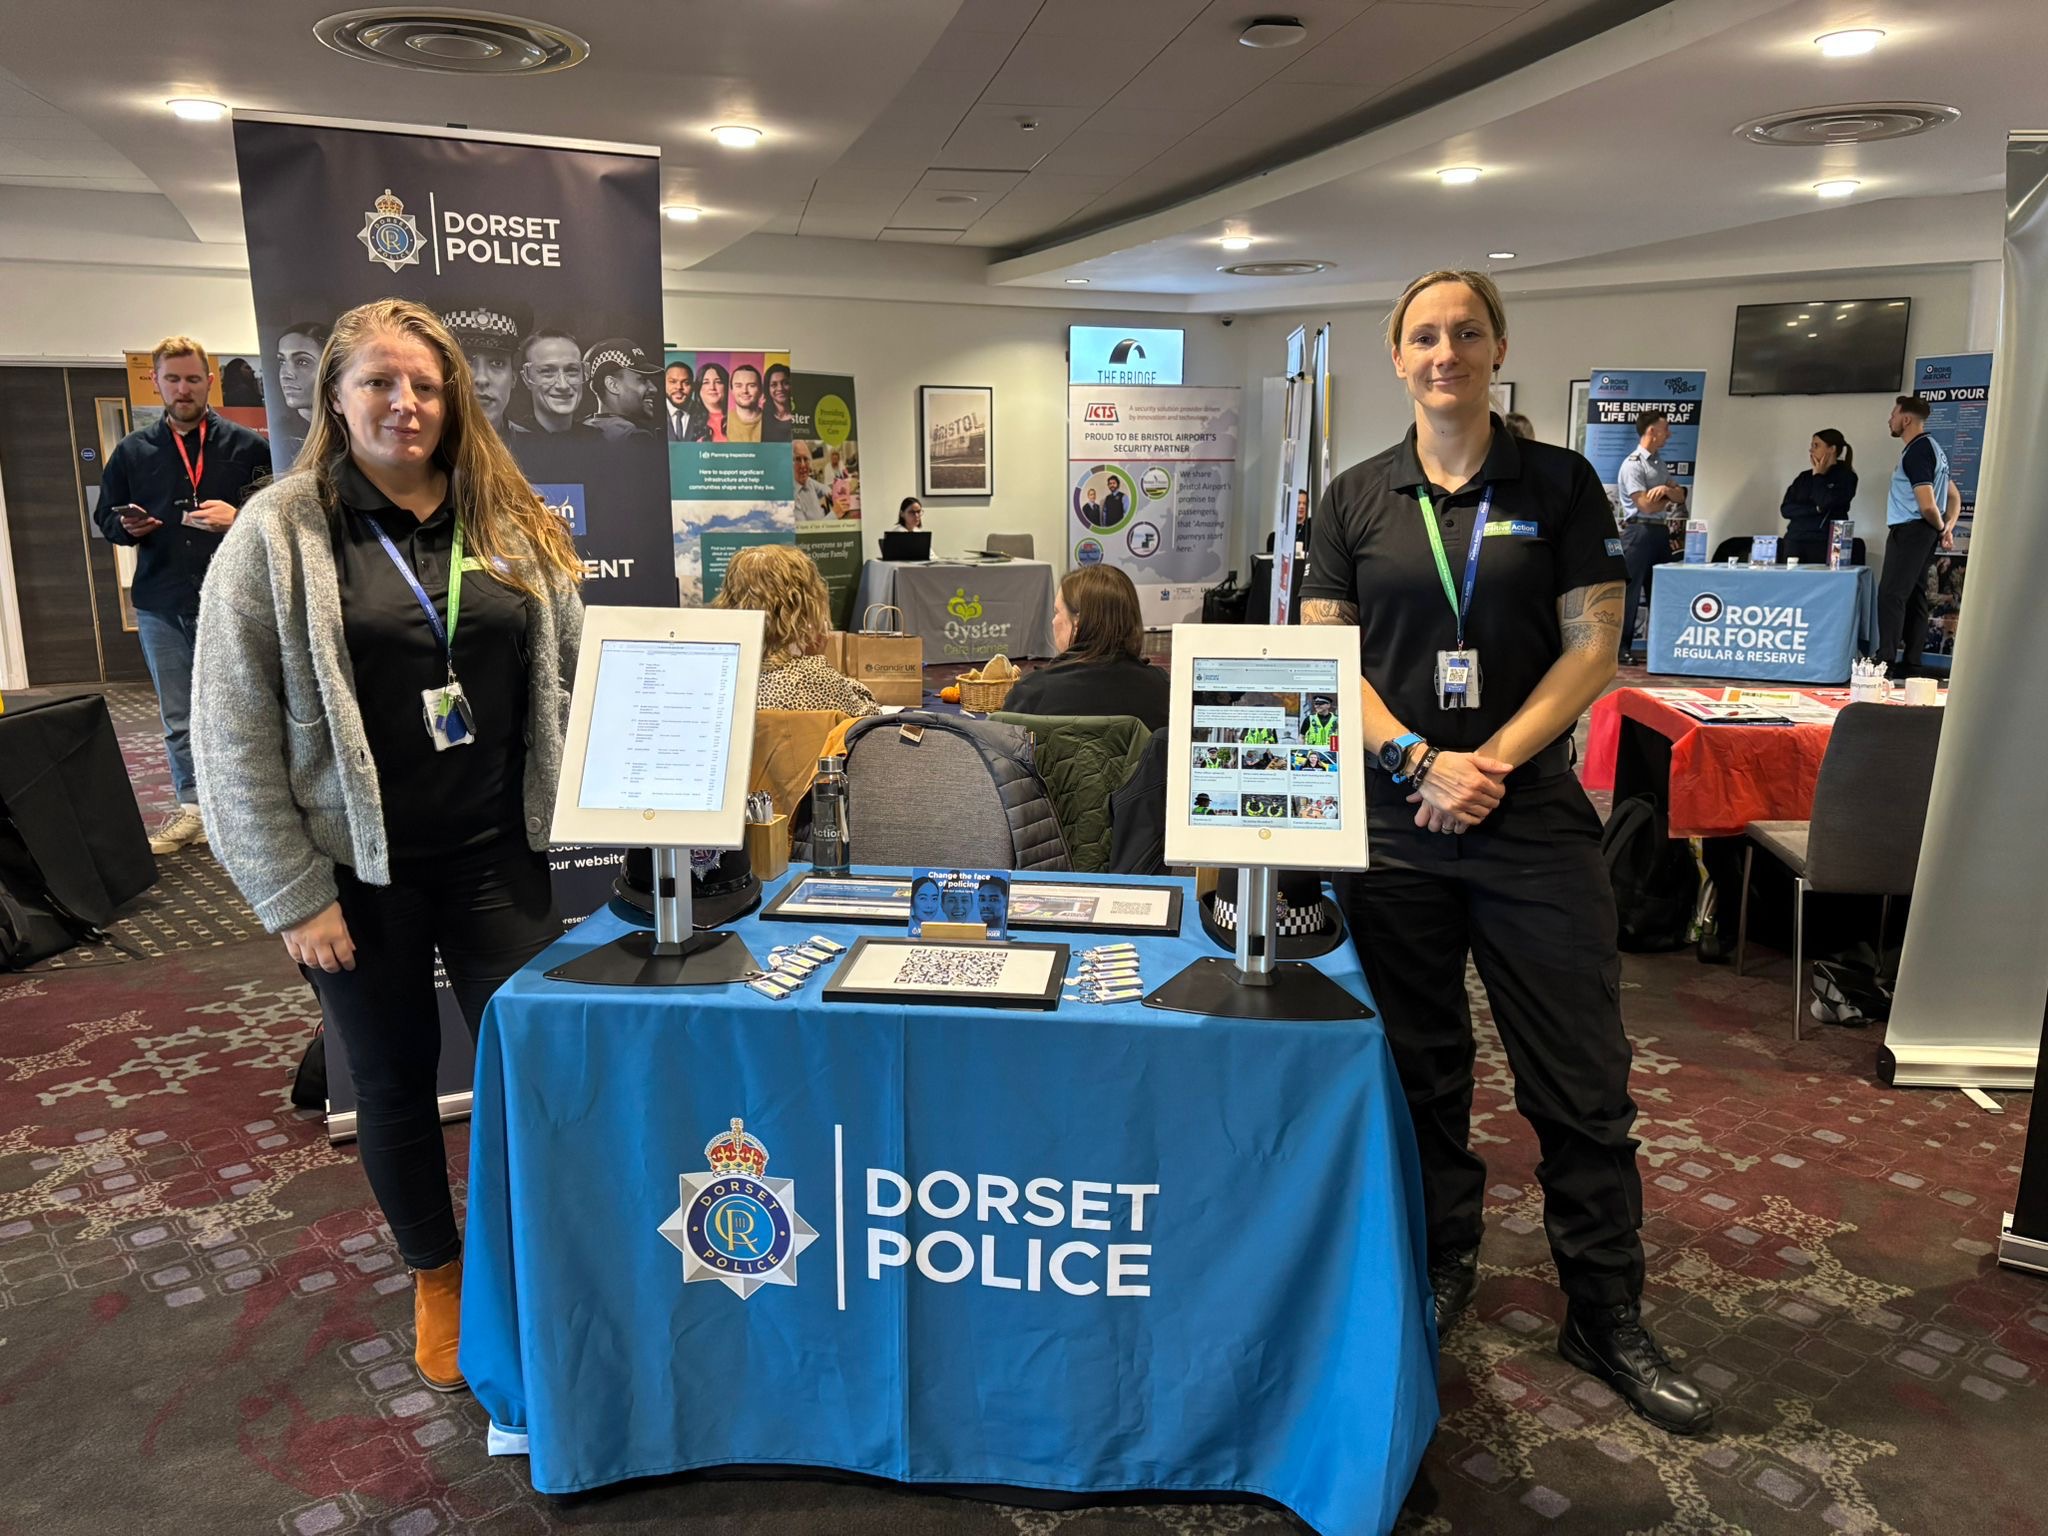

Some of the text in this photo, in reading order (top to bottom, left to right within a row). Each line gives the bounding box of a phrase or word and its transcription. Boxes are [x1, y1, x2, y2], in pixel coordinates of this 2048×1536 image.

[443, 211, 560, 240] DORSET
[446, 237, 561, 267] POLICE
[1120, 371, 1157, 385] BRIDGE
[1920, 388, 1985, 401] FIND YOUR
[1088, 405, 1117, 419] ICTS
[1597, 402, 1695, 412] THE BENEFITS OF
[1600, 412, 1690, 423] LIFE IN RAF
[1085, 432, 1217, 441] PROUD TO BE BRISTOL AIRPORT'S
[1113, 444, 1190, 453] SECURITY PARTNER
[1511, 523, 1535, 532] Action
[1725, 605, 1809, 628] ROYAL
[944, 620, 1011, 644] Oyster
[1675, 626, 1809, 650] AIR FORCE
[1673, 647, 1806, 664] REGULAR & RESERVE
[928, 871, 991, 880] Change the face
[947, 880, 980, 889] policing
[700, 1182, 779, 1211] DORSET
[866, 1167, 1160, 1232] DORSET
[703, 1249, 779, 1273] POLICE
[867, 1227, 1153, 1297] POLICE
